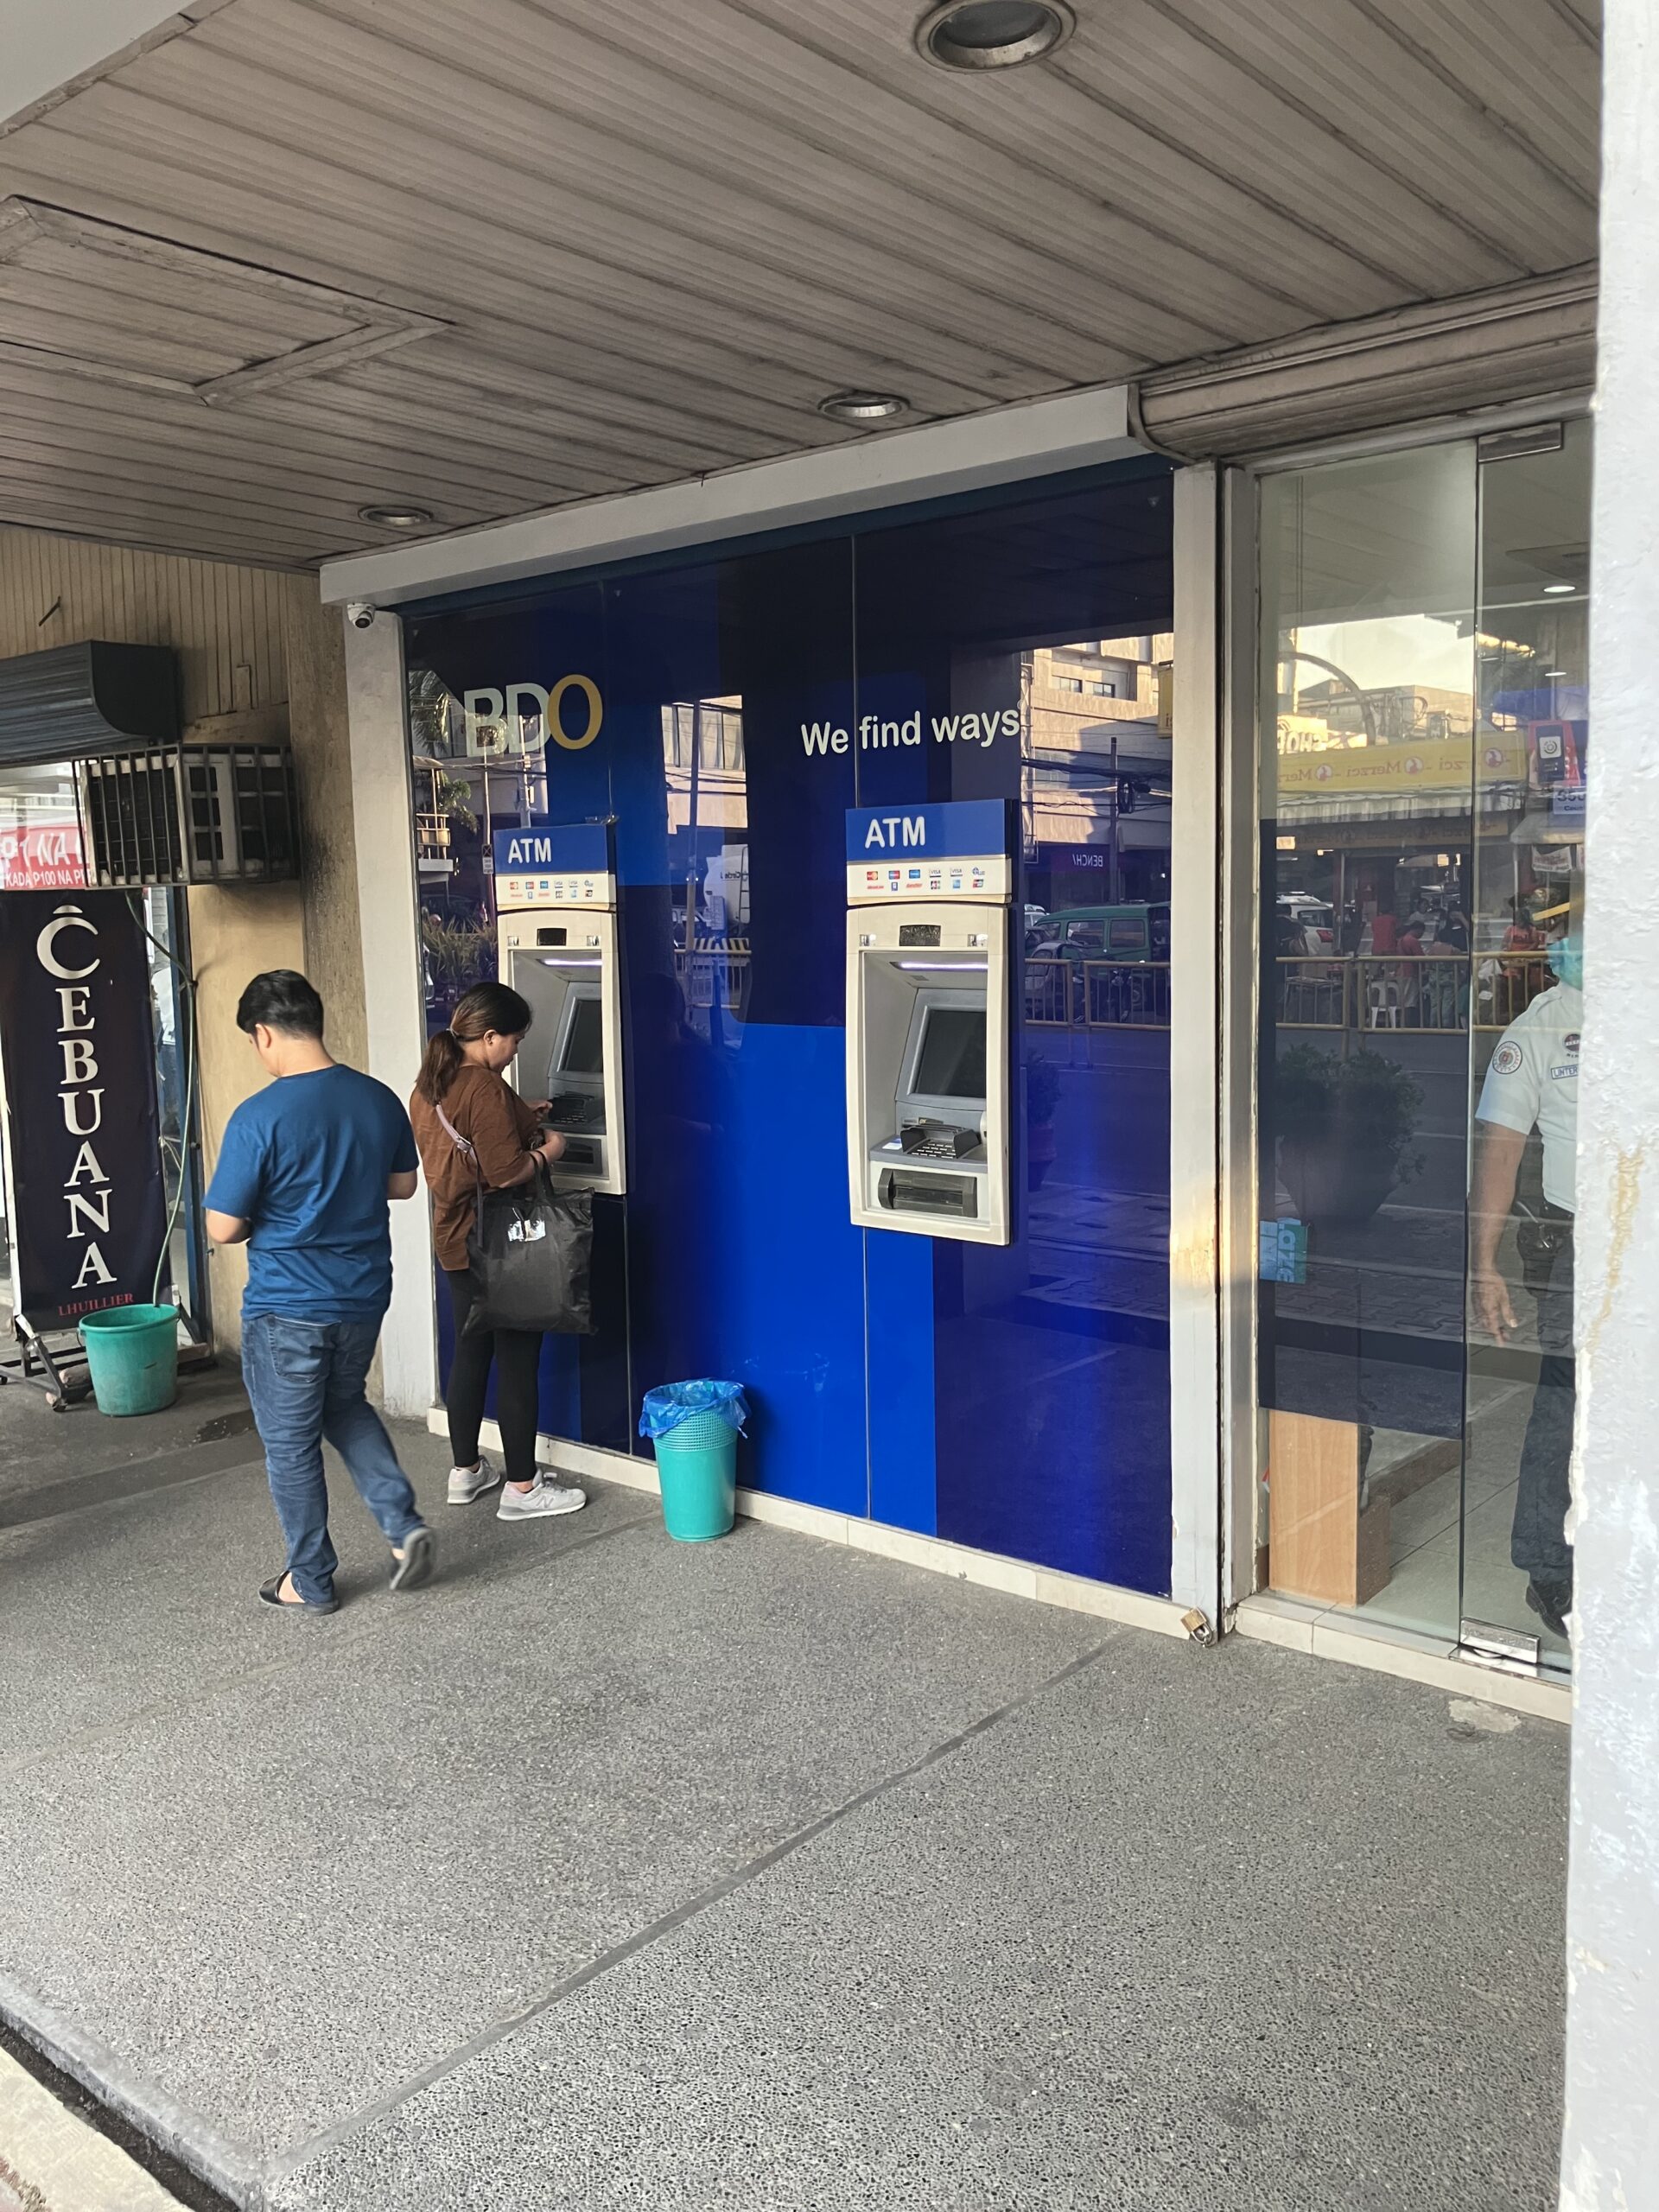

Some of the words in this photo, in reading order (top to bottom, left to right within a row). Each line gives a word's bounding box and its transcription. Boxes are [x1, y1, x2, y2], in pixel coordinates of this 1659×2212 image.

[464, 674, 603, 758] BDO
[800, 721, 849, 756] We
[858, 710, 921, 750] find
[931, 709, 1020, 748] ways
[36, 832, 71, 866] NA
[864, 816, 925, 849] ATM
[507, 837, 552, 864] ATM
[6, 871, 32, 887] KADA
[33, 870, 56, 886] P100
[58, 869, 73, 885] NA
[36, 904, 118, 1289] CEBUANA
[58, 1293, 135, 1317] LHUILLIER
